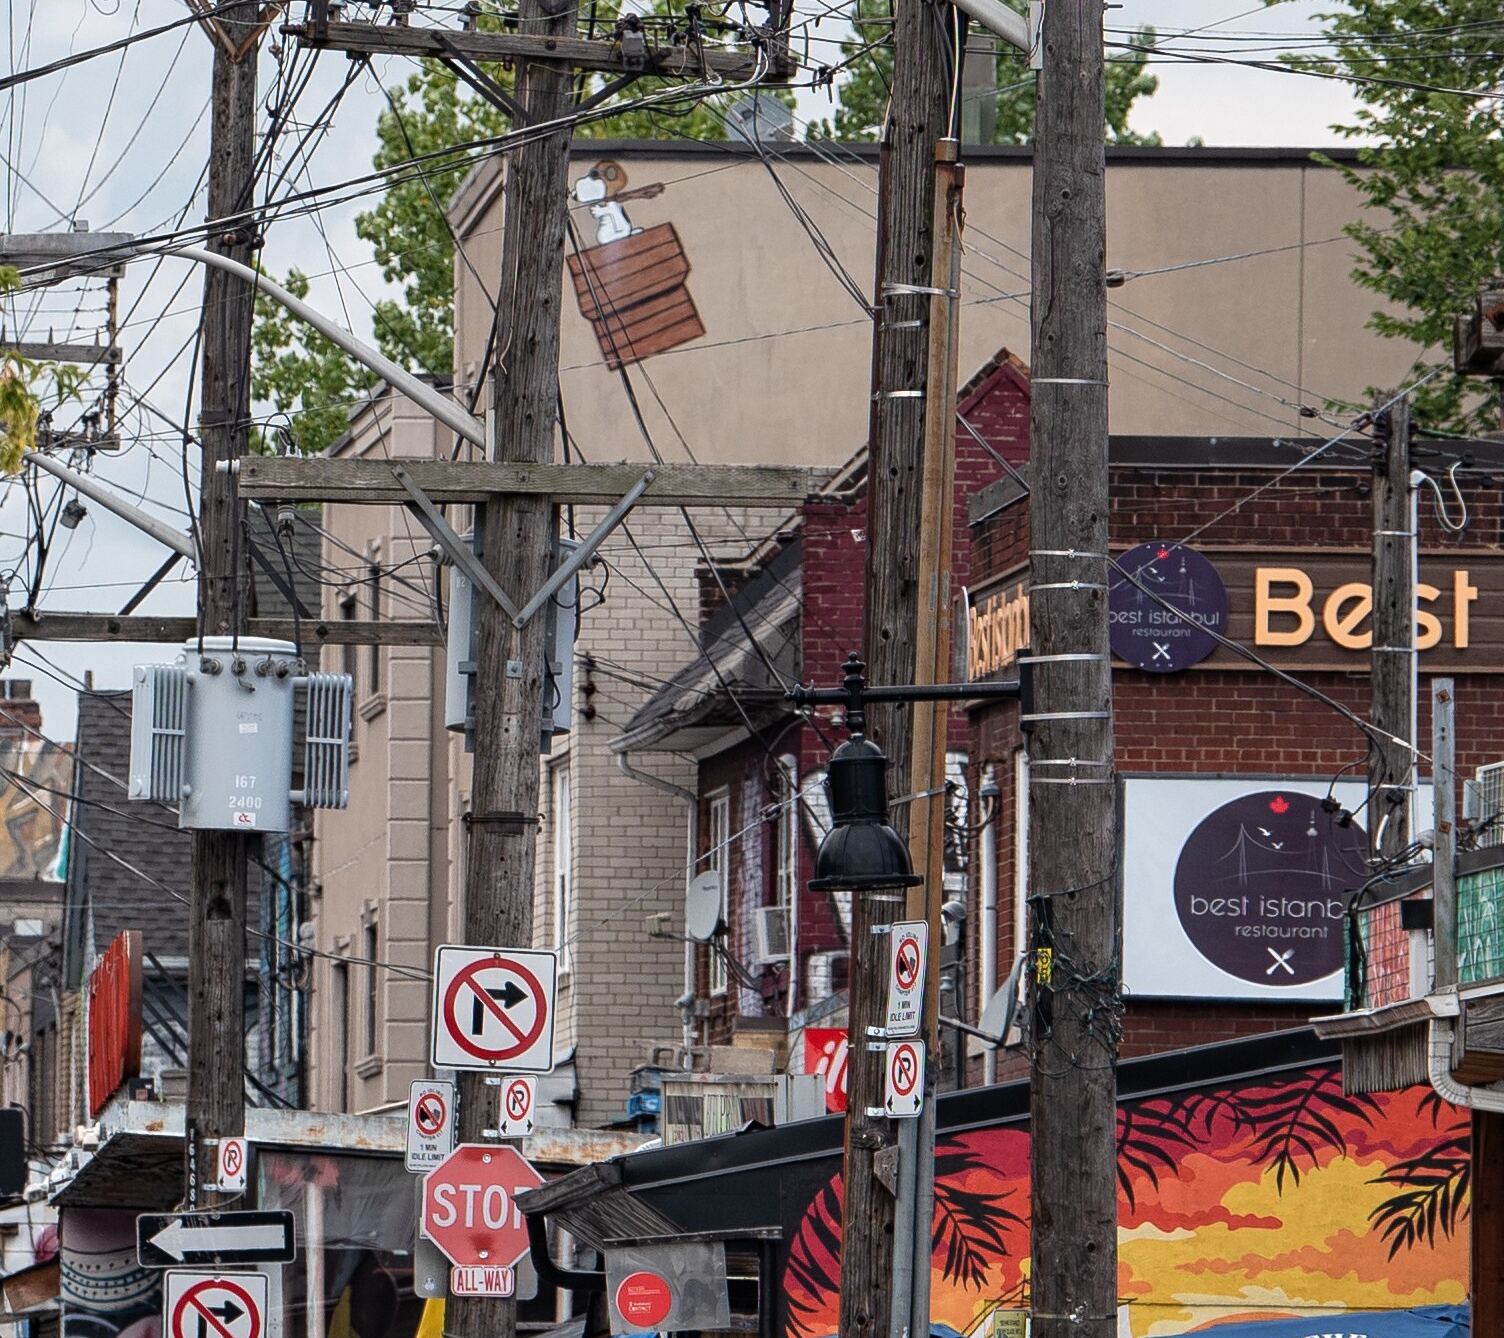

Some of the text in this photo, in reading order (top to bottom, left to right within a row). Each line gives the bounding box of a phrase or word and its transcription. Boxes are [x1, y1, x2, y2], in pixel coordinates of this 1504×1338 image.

[1255, 567, 1478, 652] Best
[1132, 627, 1191, 638] restaurant
[235, 775, 257, 789] 167
[228, 796, 262, 809] 2400
[1191, 894, 1249, 917] best
[1235, 925, 1329, 939] restaurant
[412, 1153, 426, 1161] IDLE
[457, 1271, 508, 1292] ALL-WAY
